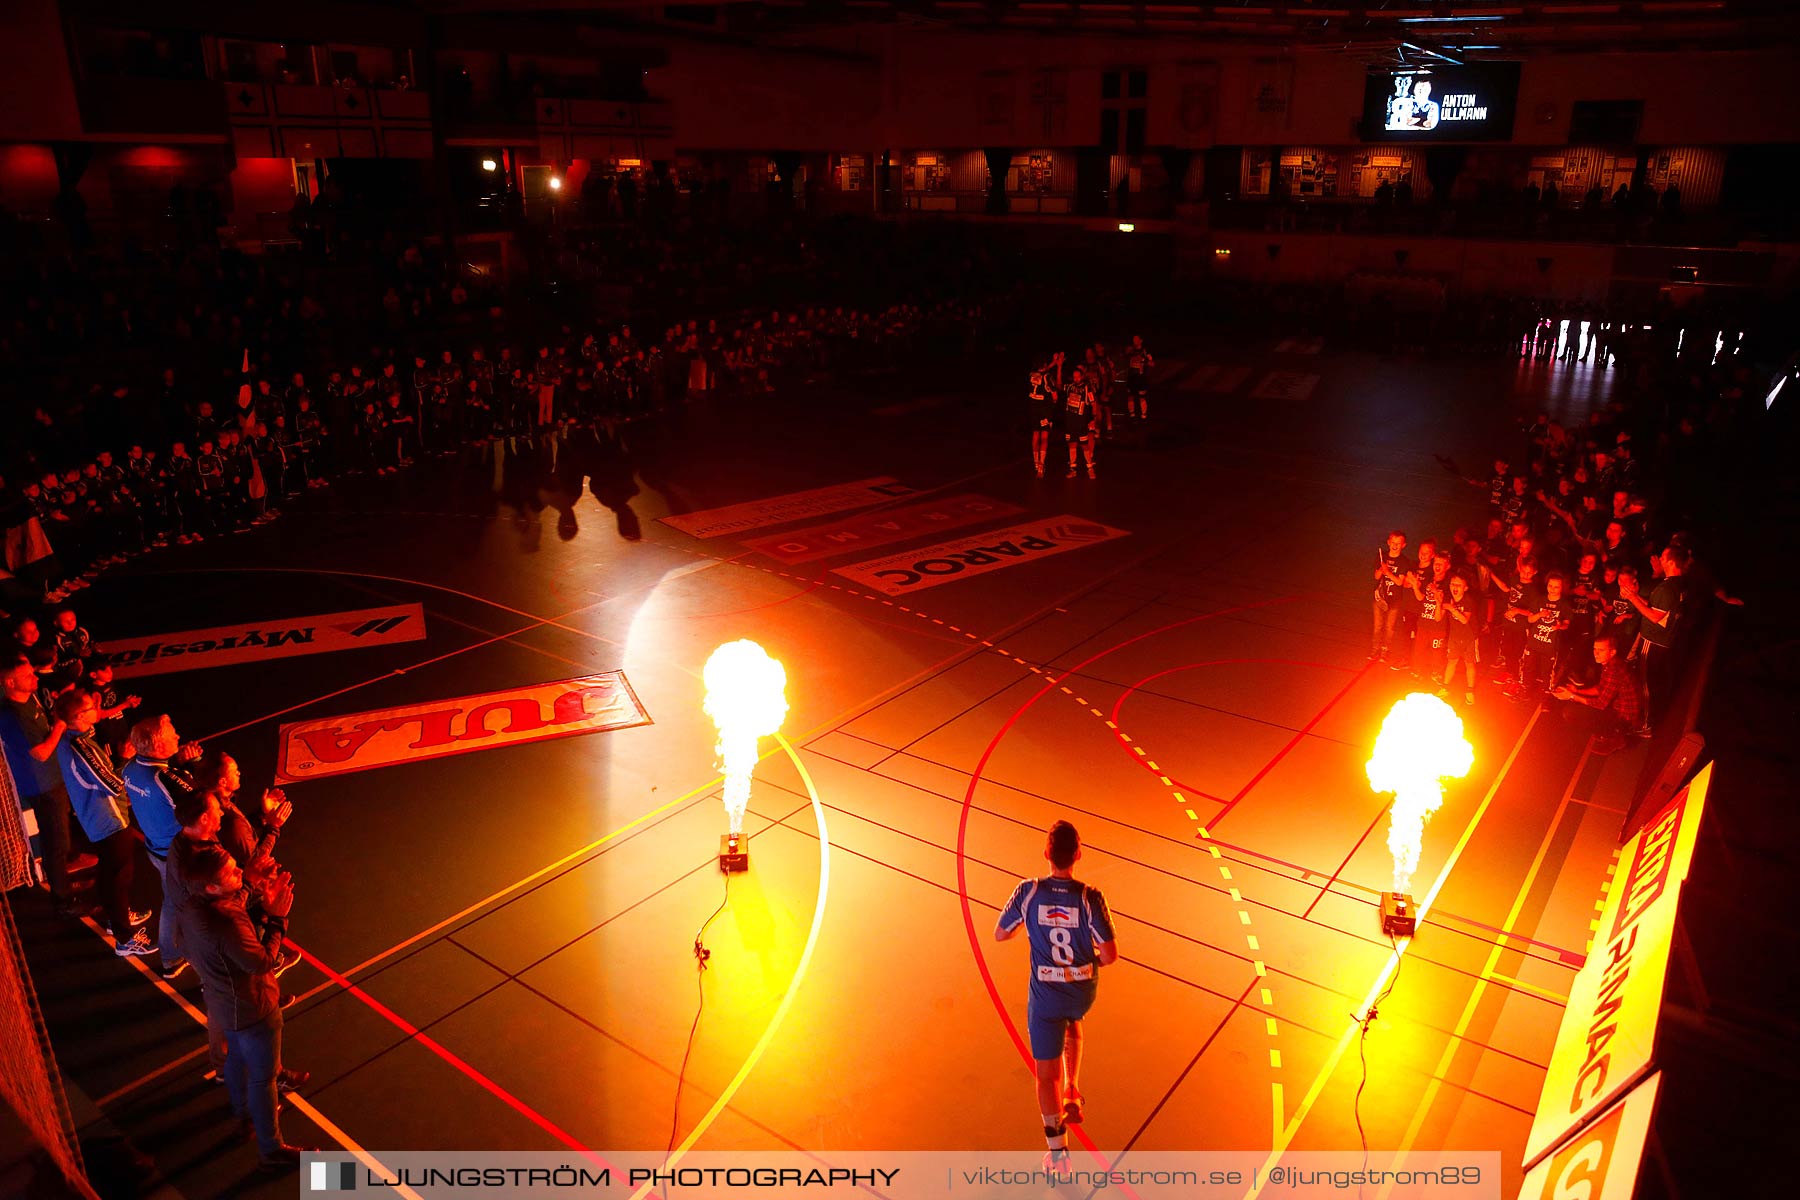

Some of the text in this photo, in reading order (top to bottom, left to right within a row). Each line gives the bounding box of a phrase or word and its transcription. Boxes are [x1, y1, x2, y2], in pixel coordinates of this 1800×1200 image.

[1440, 106, 1488, 120] ULLMANN
[1442, 94, 1476, 107] ANTON
[873, 535, 1057, 586] PAROC
[293, 686, 617, 763] JULA
[1618, 808, 1678, 928] EXTRA
[1049, 927, 1074, 966] 8
